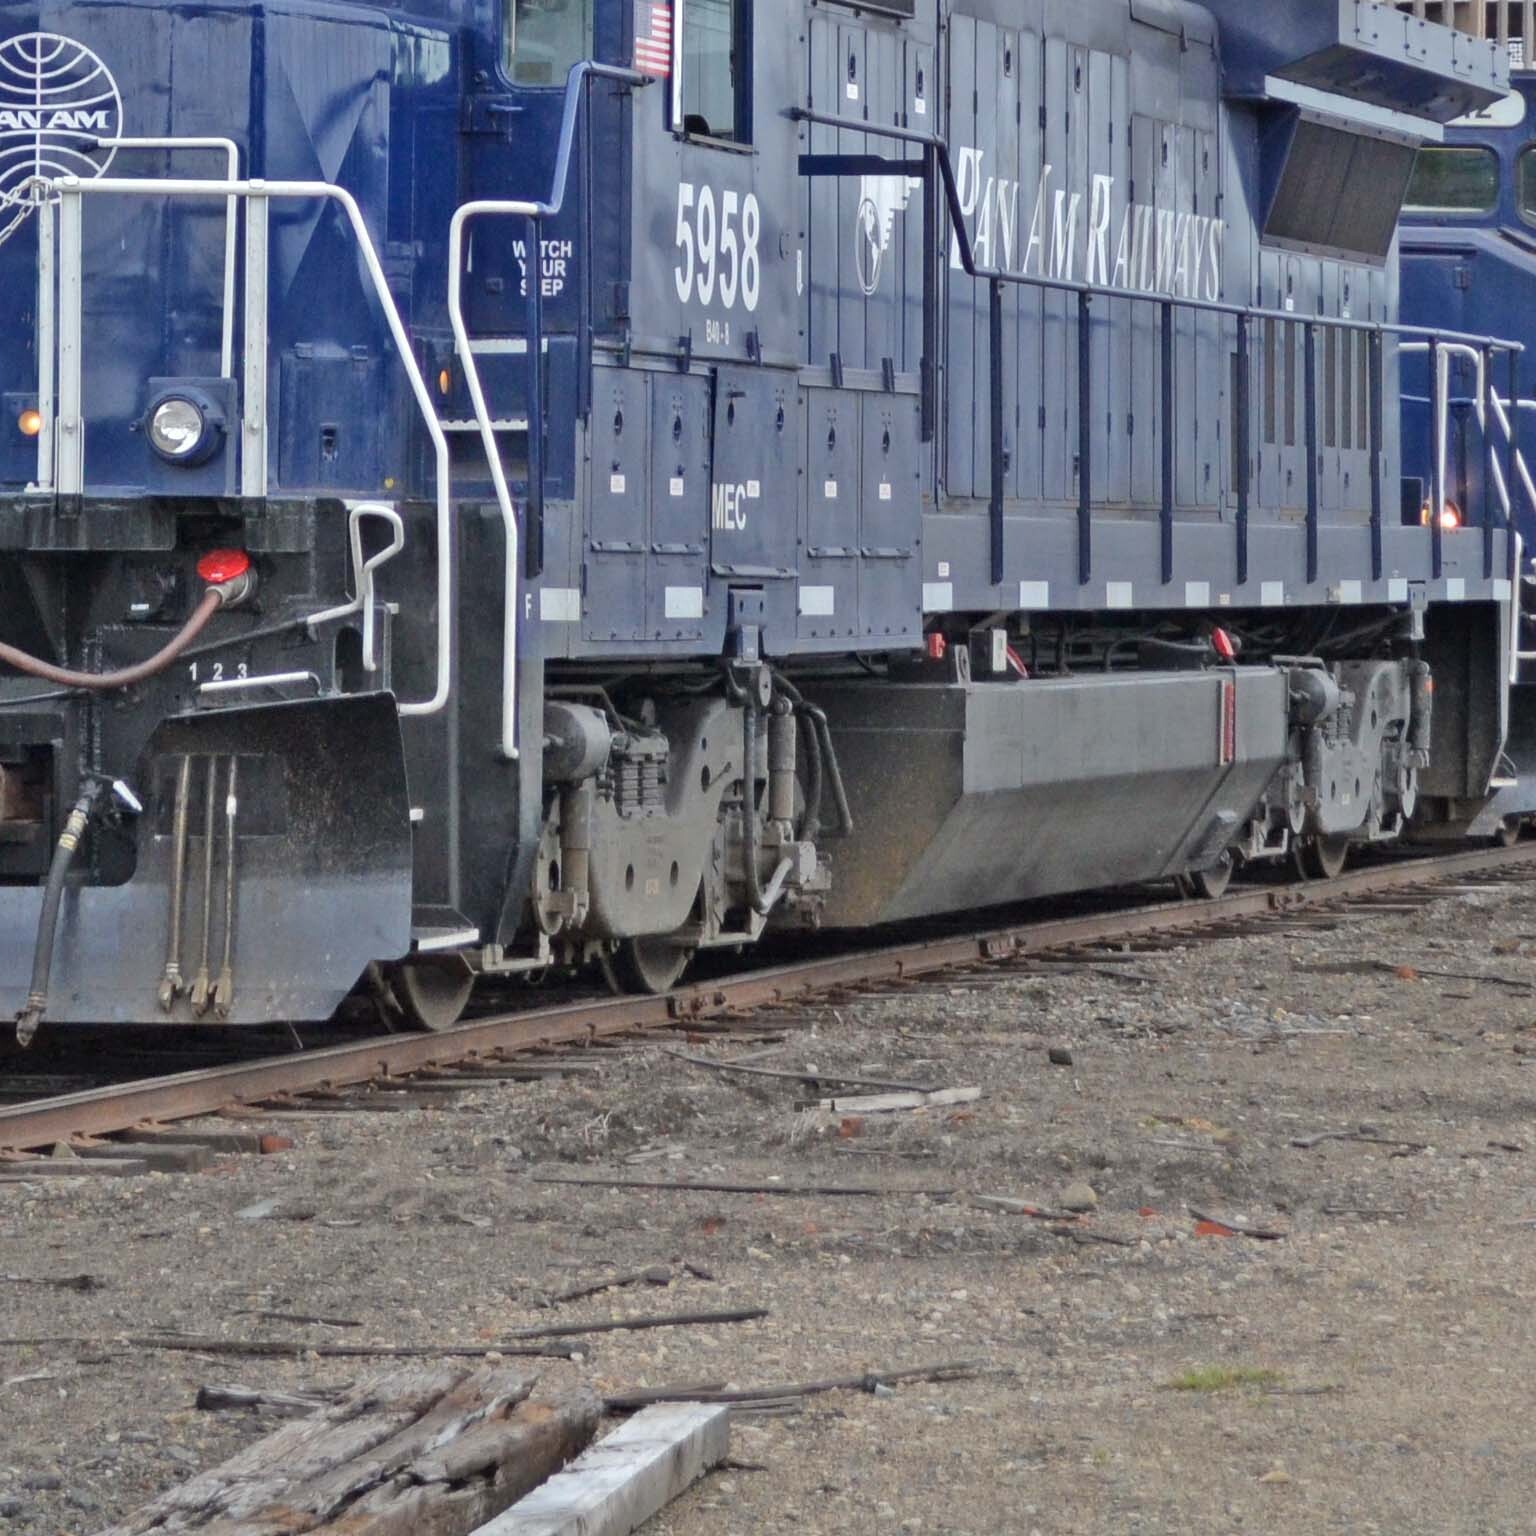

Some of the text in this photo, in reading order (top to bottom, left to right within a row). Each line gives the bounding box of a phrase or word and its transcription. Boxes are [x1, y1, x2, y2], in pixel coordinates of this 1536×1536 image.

[45, 111, 110, 129] AM
[950, 146, 1224, 302] PAN AM RAILWAYS
[512, 240, 572, 258] WTCH
[675, 183, 760, 311] 5958
[518, 259, 566, 276] YUR
[520, 279, 563, 296] SEP
[712, 483, 746, 530] MEC
[525, 593, 532, 620] F
[189, 662, 247, 681] 1 2 3
